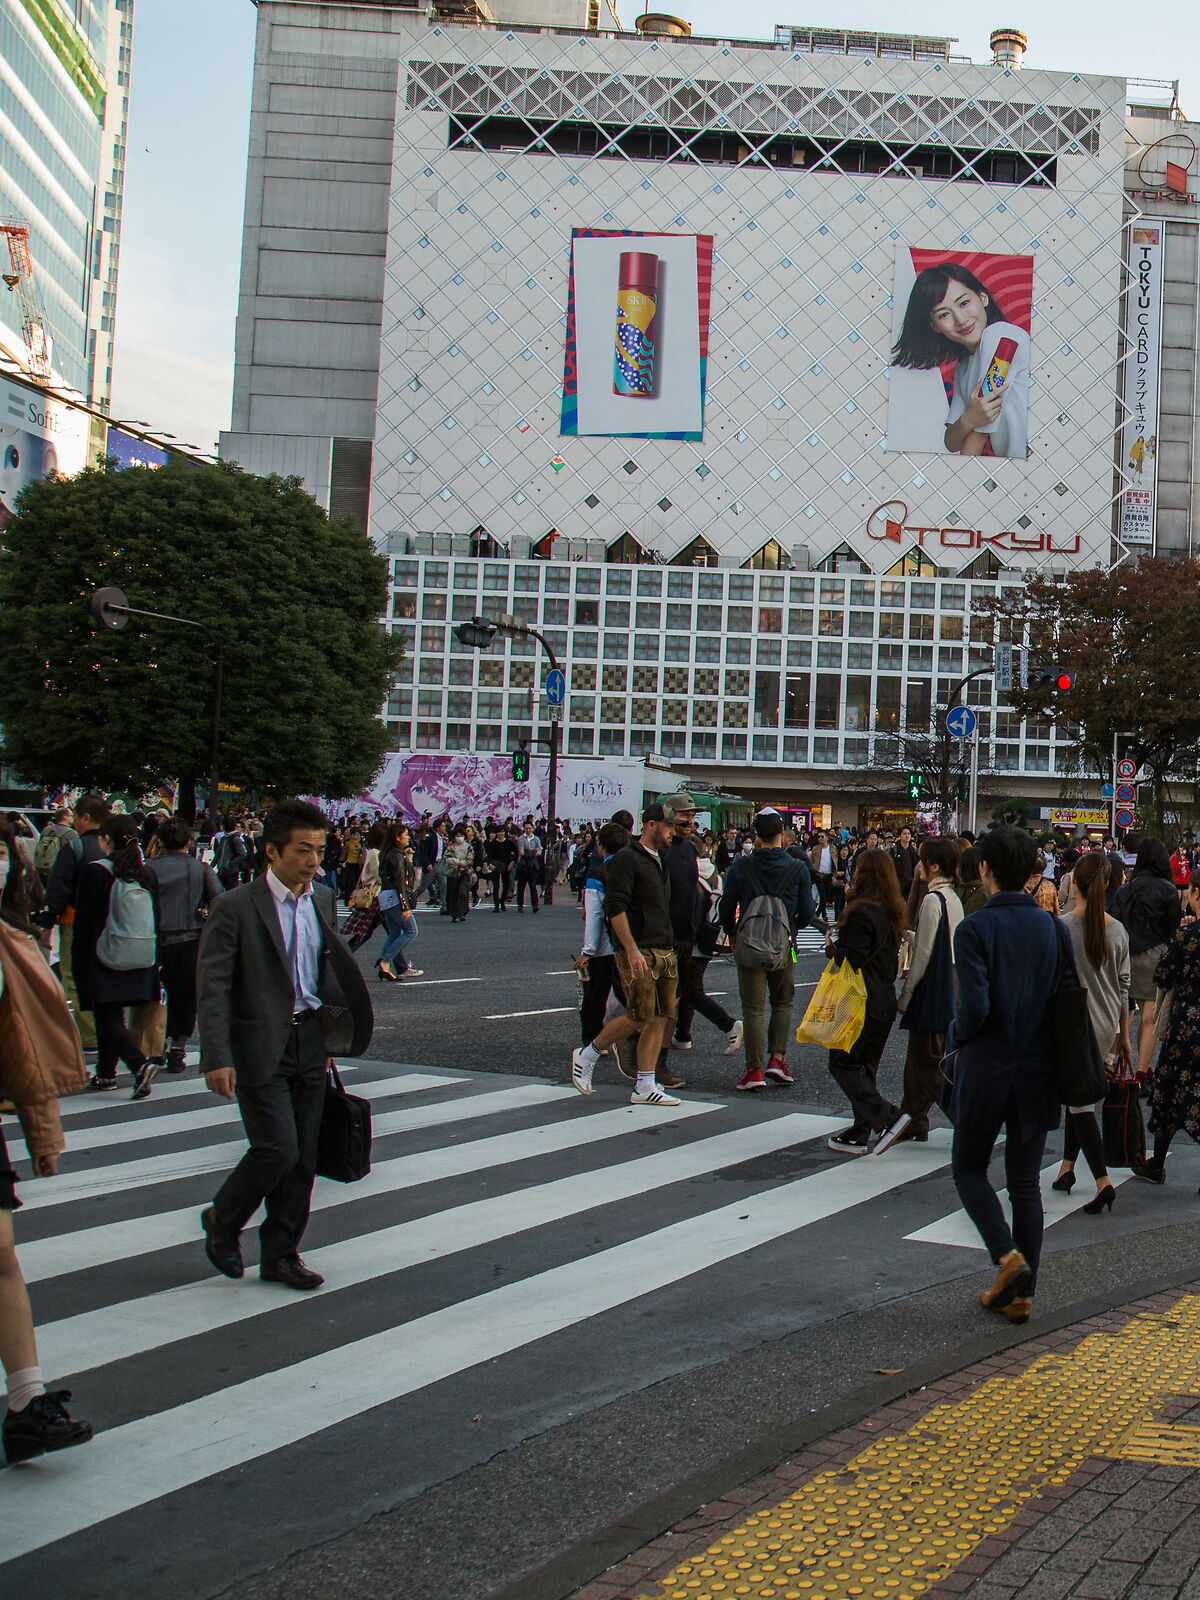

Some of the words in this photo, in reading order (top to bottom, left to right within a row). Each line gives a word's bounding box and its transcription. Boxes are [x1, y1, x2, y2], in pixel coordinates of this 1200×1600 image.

[1138, 247, 1152, 309] TOKYU
[1137, 313, 1149, 364] CARD
[903, 526, 1081, 554] TOKYU
